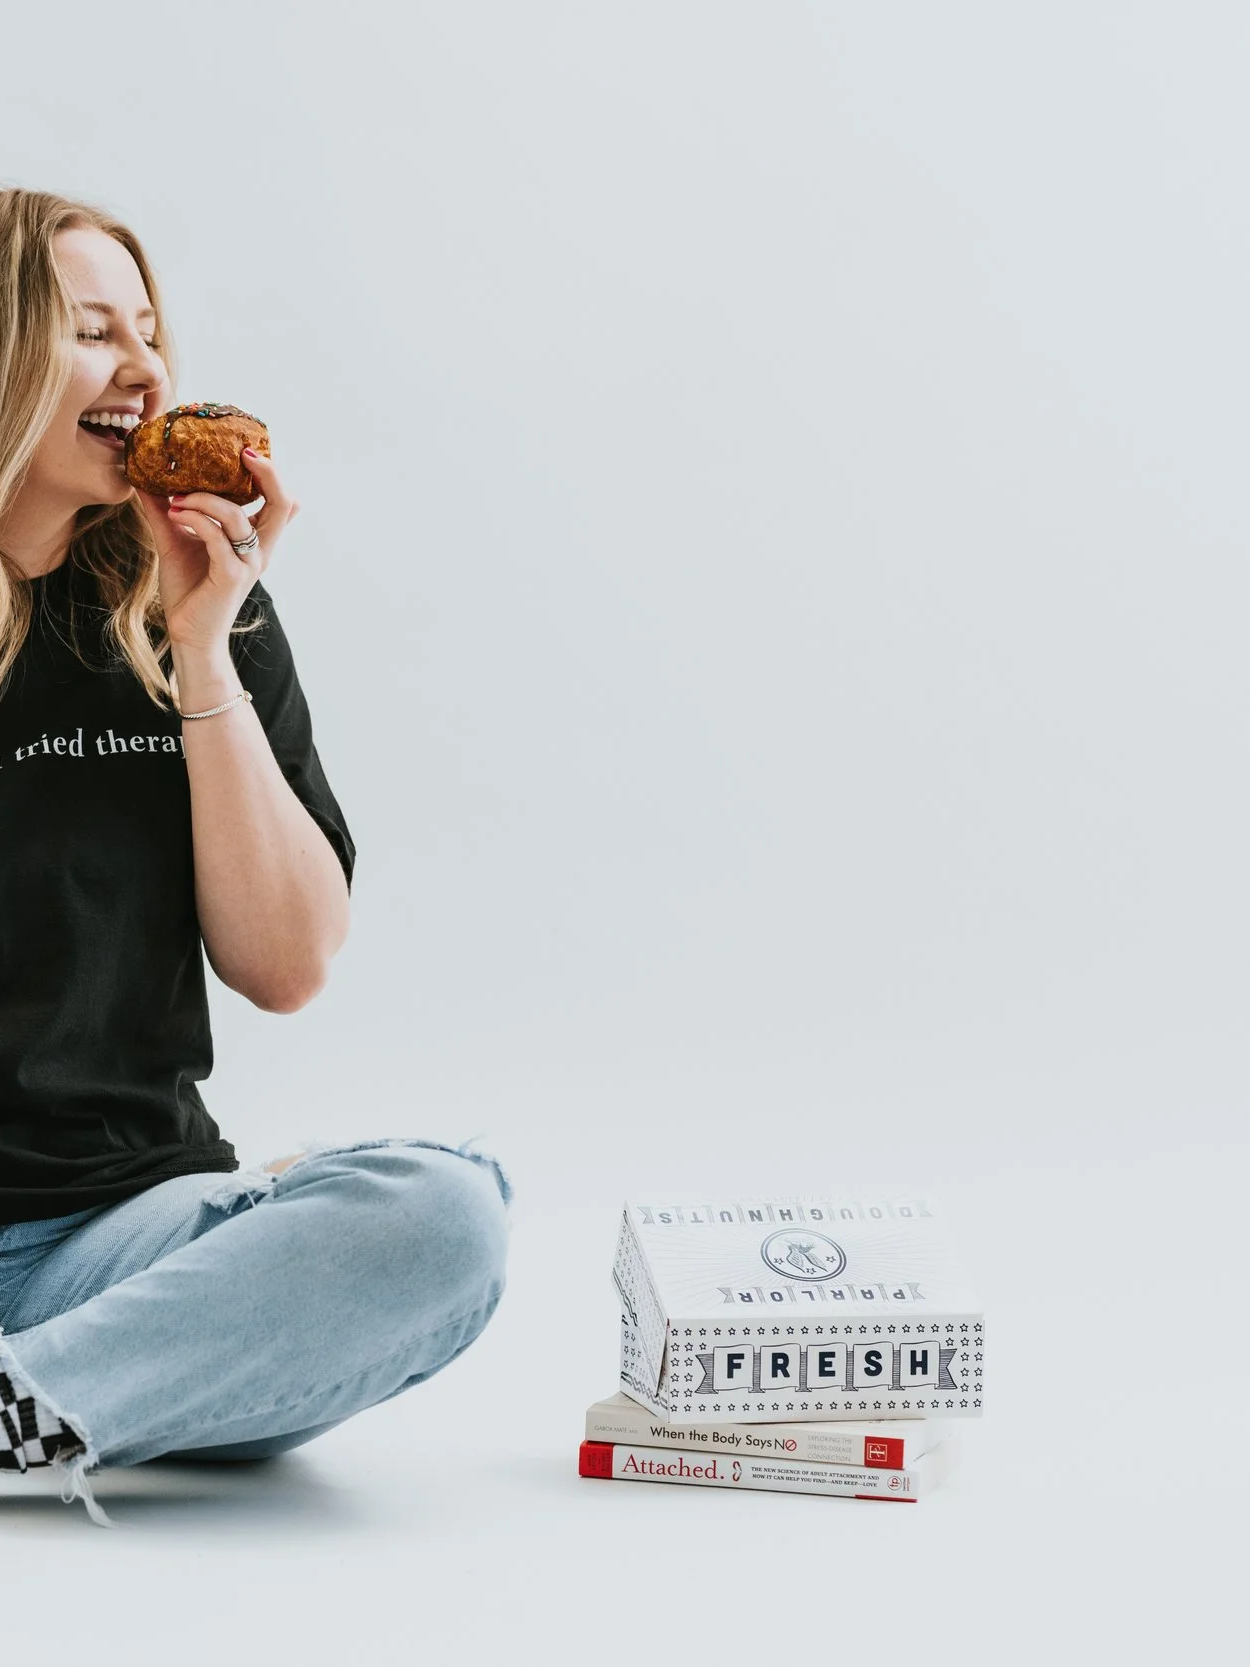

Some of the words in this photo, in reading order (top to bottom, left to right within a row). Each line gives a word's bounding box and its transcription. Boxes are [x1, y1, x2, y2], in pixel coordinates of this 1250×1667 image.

[15, 728, 85, 761] tried
[659, 1206, 913, 1223] DOUGHNUTS
[739, 1288, 907, 1303] PARLOR
[727, 1350, 928, 1379] FRESH
[650, 1426, 685, 1440] When
[689, 1429, 708, 1442] the
[712, 1432, 742, 1447] Body
[745, 1435, 773, 1449] Says
[622, 1454, 724, 1480] Attached.
[829, 1472, 866, 1480] ATTACHMENT
